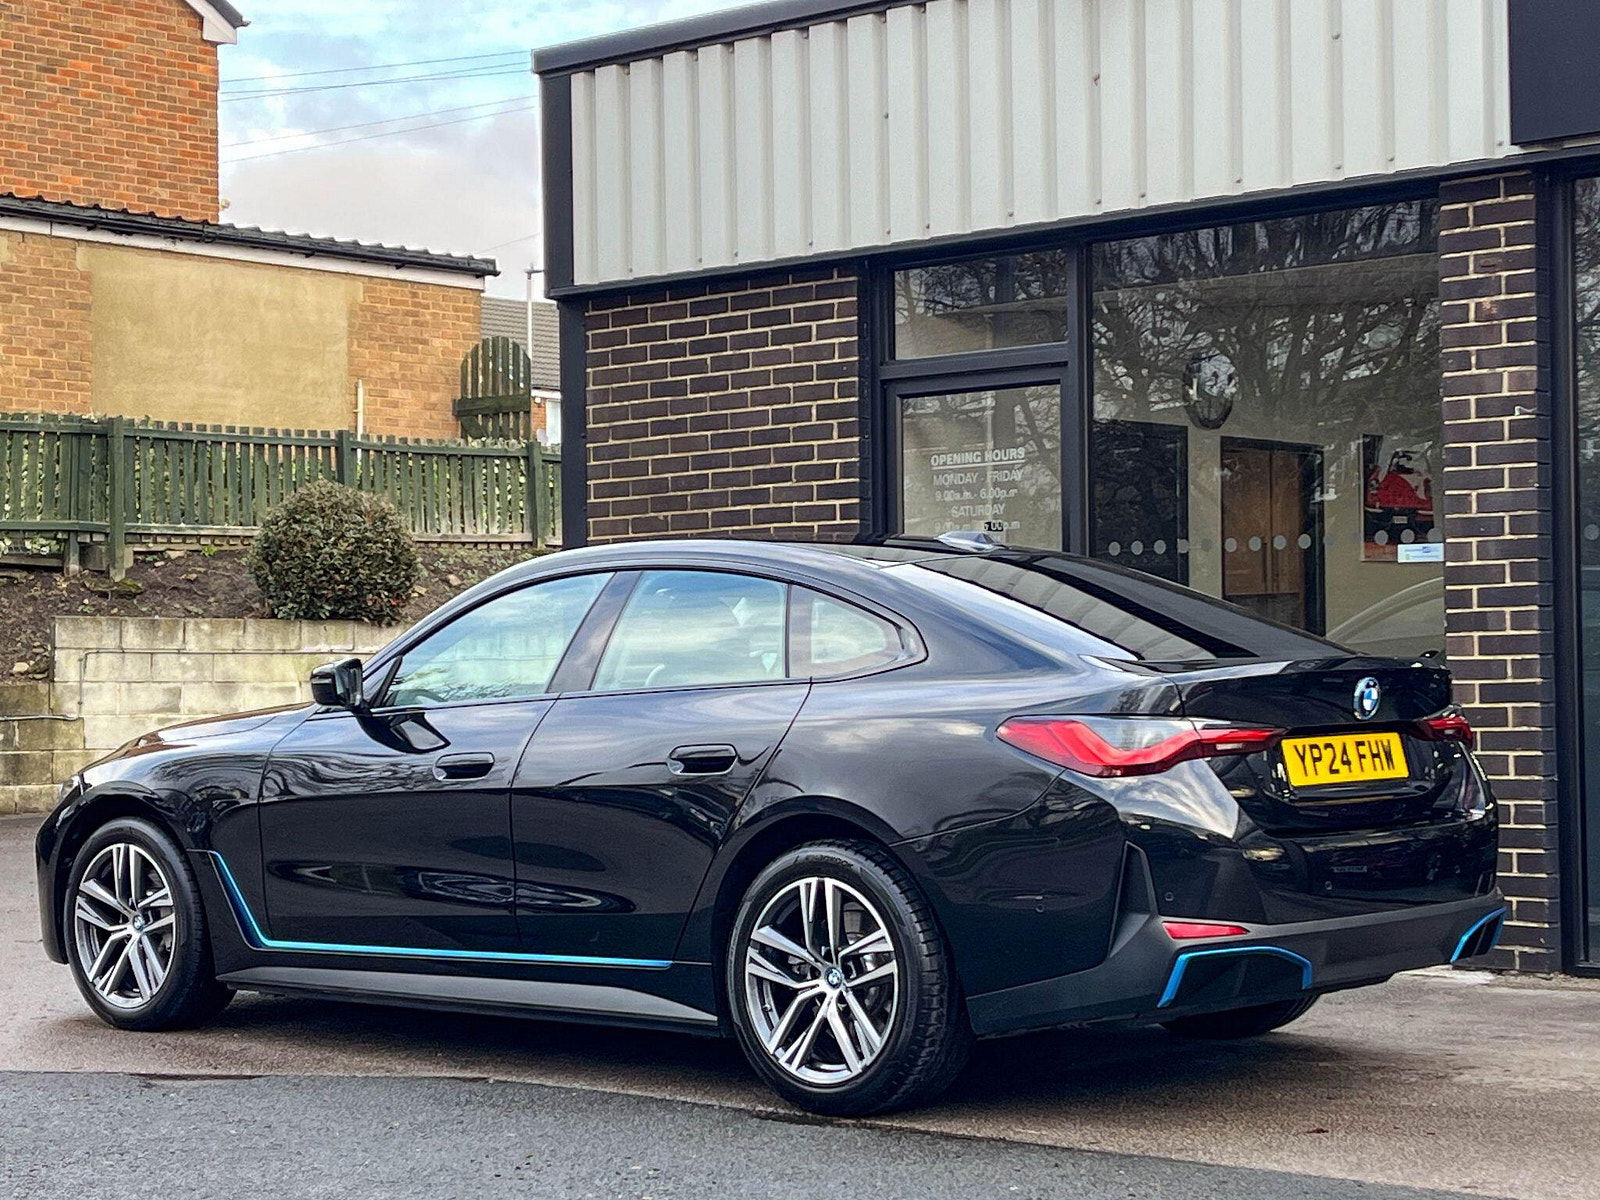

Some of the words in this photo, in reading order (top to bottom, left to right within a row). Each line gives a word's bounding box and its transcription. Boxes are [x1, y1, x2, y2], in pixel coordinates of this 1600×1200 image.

[931, 452, 981, 466] OPENING
[984, 447, 1025, 461] HOURS
[933, 473, 978, 486] MONDAY
[986, 469, 1024, 483] FRIDAY
[951, 504, 1005, 518] SATURDAY
[1292, 742, 1353, 777] YP24
[1354, 738, 1396, 773] FHW
